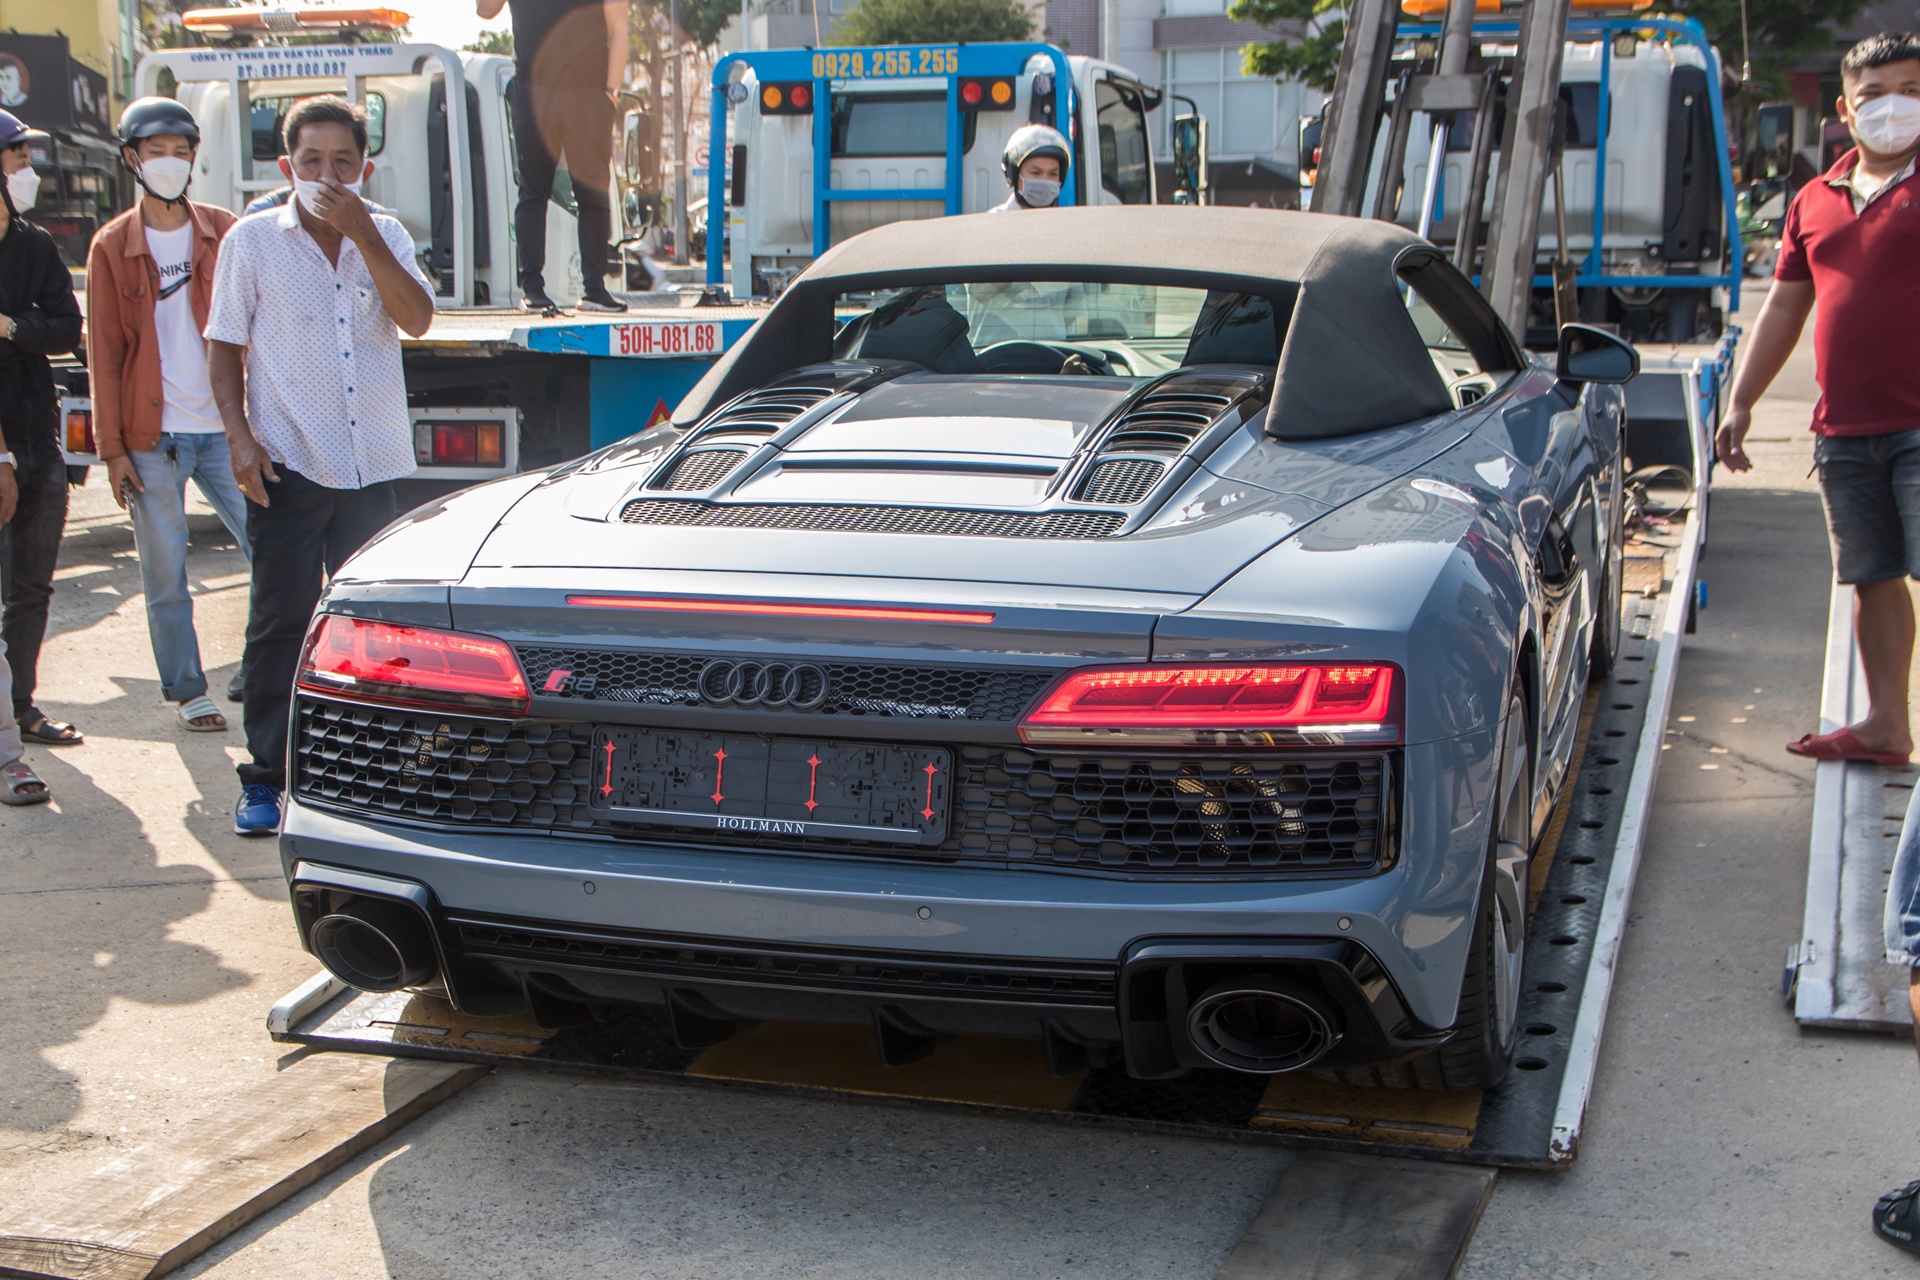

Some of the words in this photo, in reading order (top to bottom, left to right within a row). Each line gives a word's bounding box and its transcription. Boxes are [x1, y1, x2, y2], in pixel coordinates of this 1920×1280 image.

[220, 52, 232, 61] TY
[236, 51, 264, 60] TNHH
[267, 50, 280, 59] DV
[812, 49, 958, 78] 0929.255.255
[262, 63, 292, 77] 0977
[297, 61, 319, 76] 000
[324, 60, 346, 75] 097
[160, 261, 192, 277] NIKE
[620, 324, 714, 355] 50H-081.68
[553, 674, 597, 692] R8
[717, 818, 805, 834] HOLLMANN
